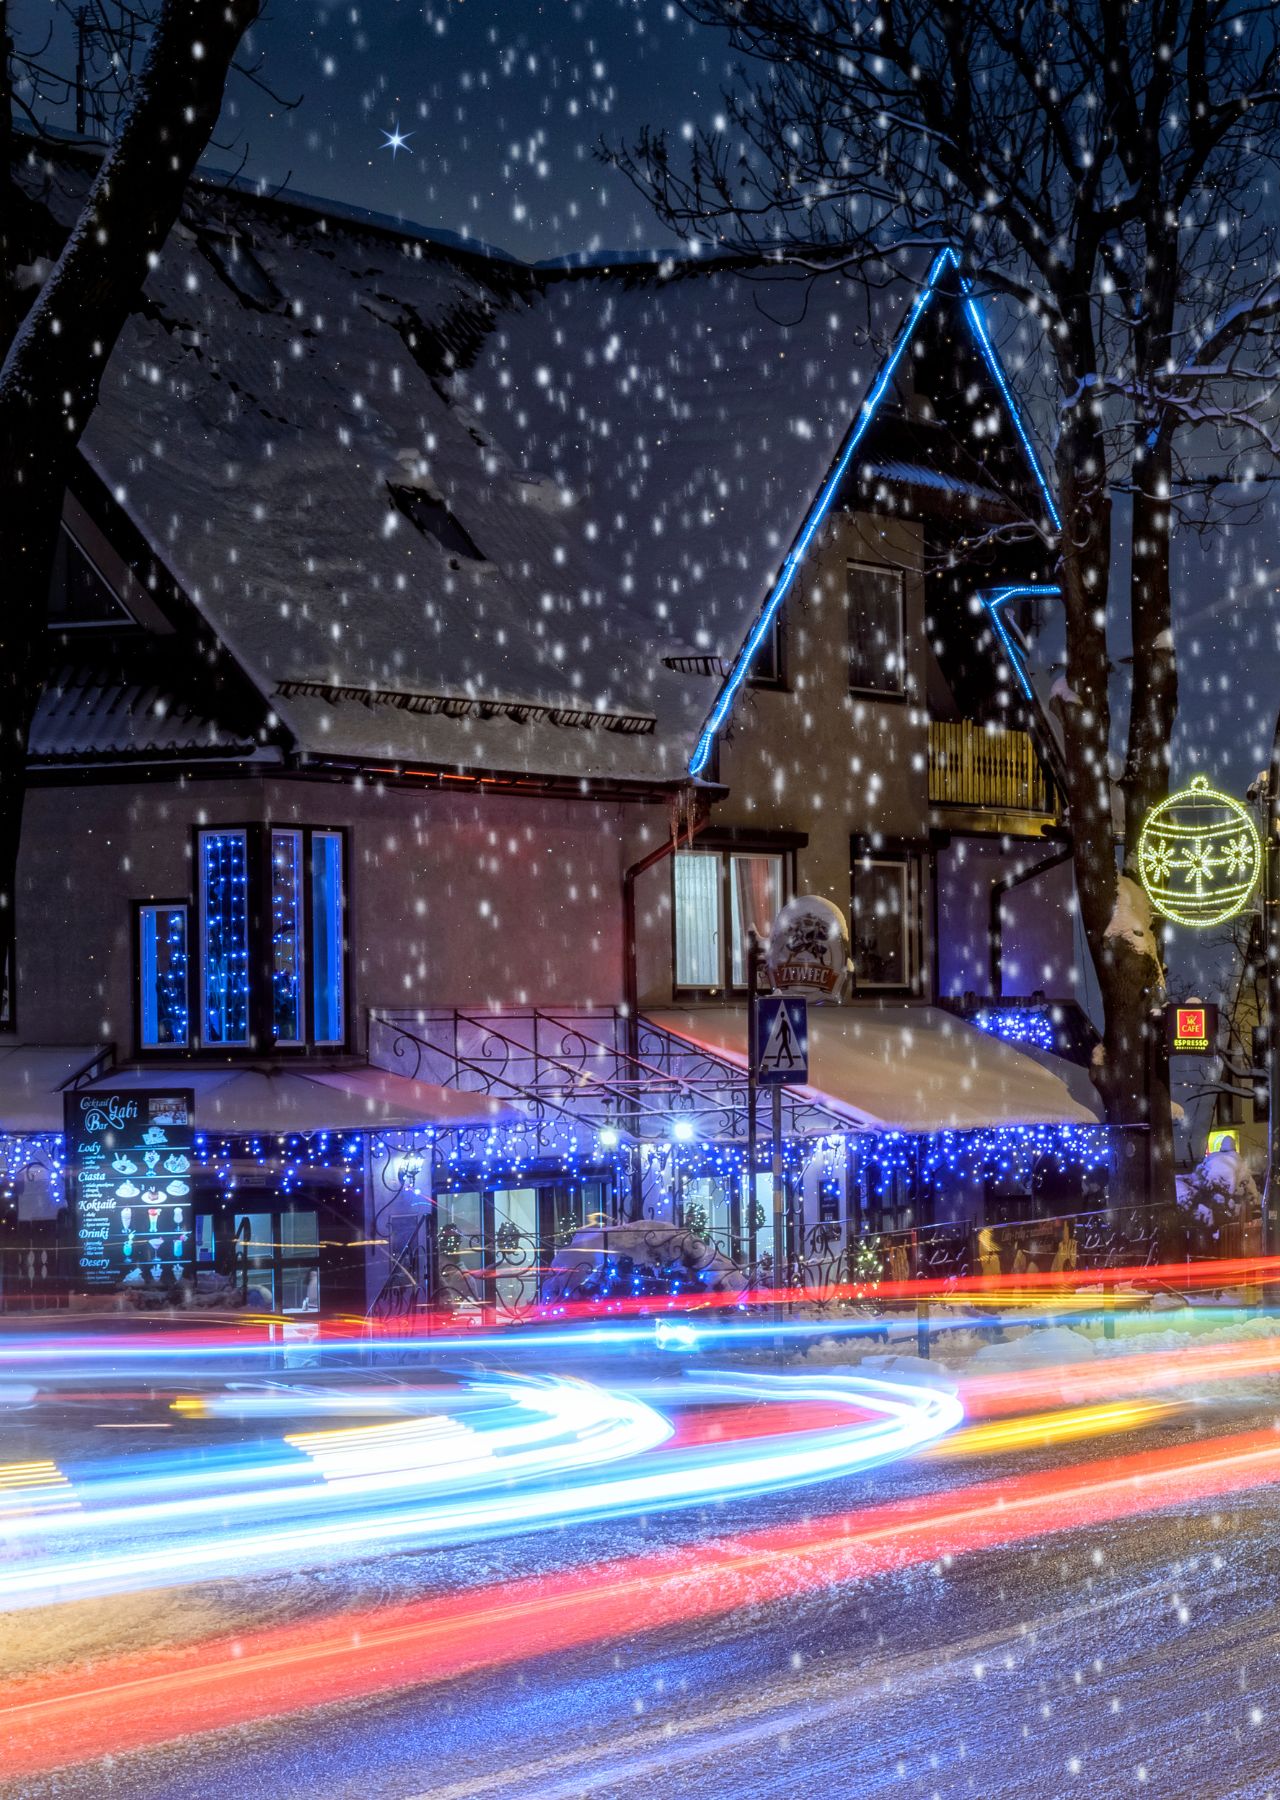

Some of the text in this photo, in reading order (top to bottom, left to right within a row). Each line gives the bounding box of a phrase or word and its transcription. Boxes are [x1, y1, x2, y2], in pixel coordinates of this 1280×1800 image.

[1174, 1039, 1209, 1047] ESPRESSO
[80, 1095, 138, 1120] Cocktail Gabi
[78, 1142, 101, 1155] Lody
[78, 1172, 106, 1182] Ciasta
[79, 1198, 117, 1211] Koktaile
[79, 1227, 109, 1240] Drinki
[80, 1258, 109, 1269] Desery
